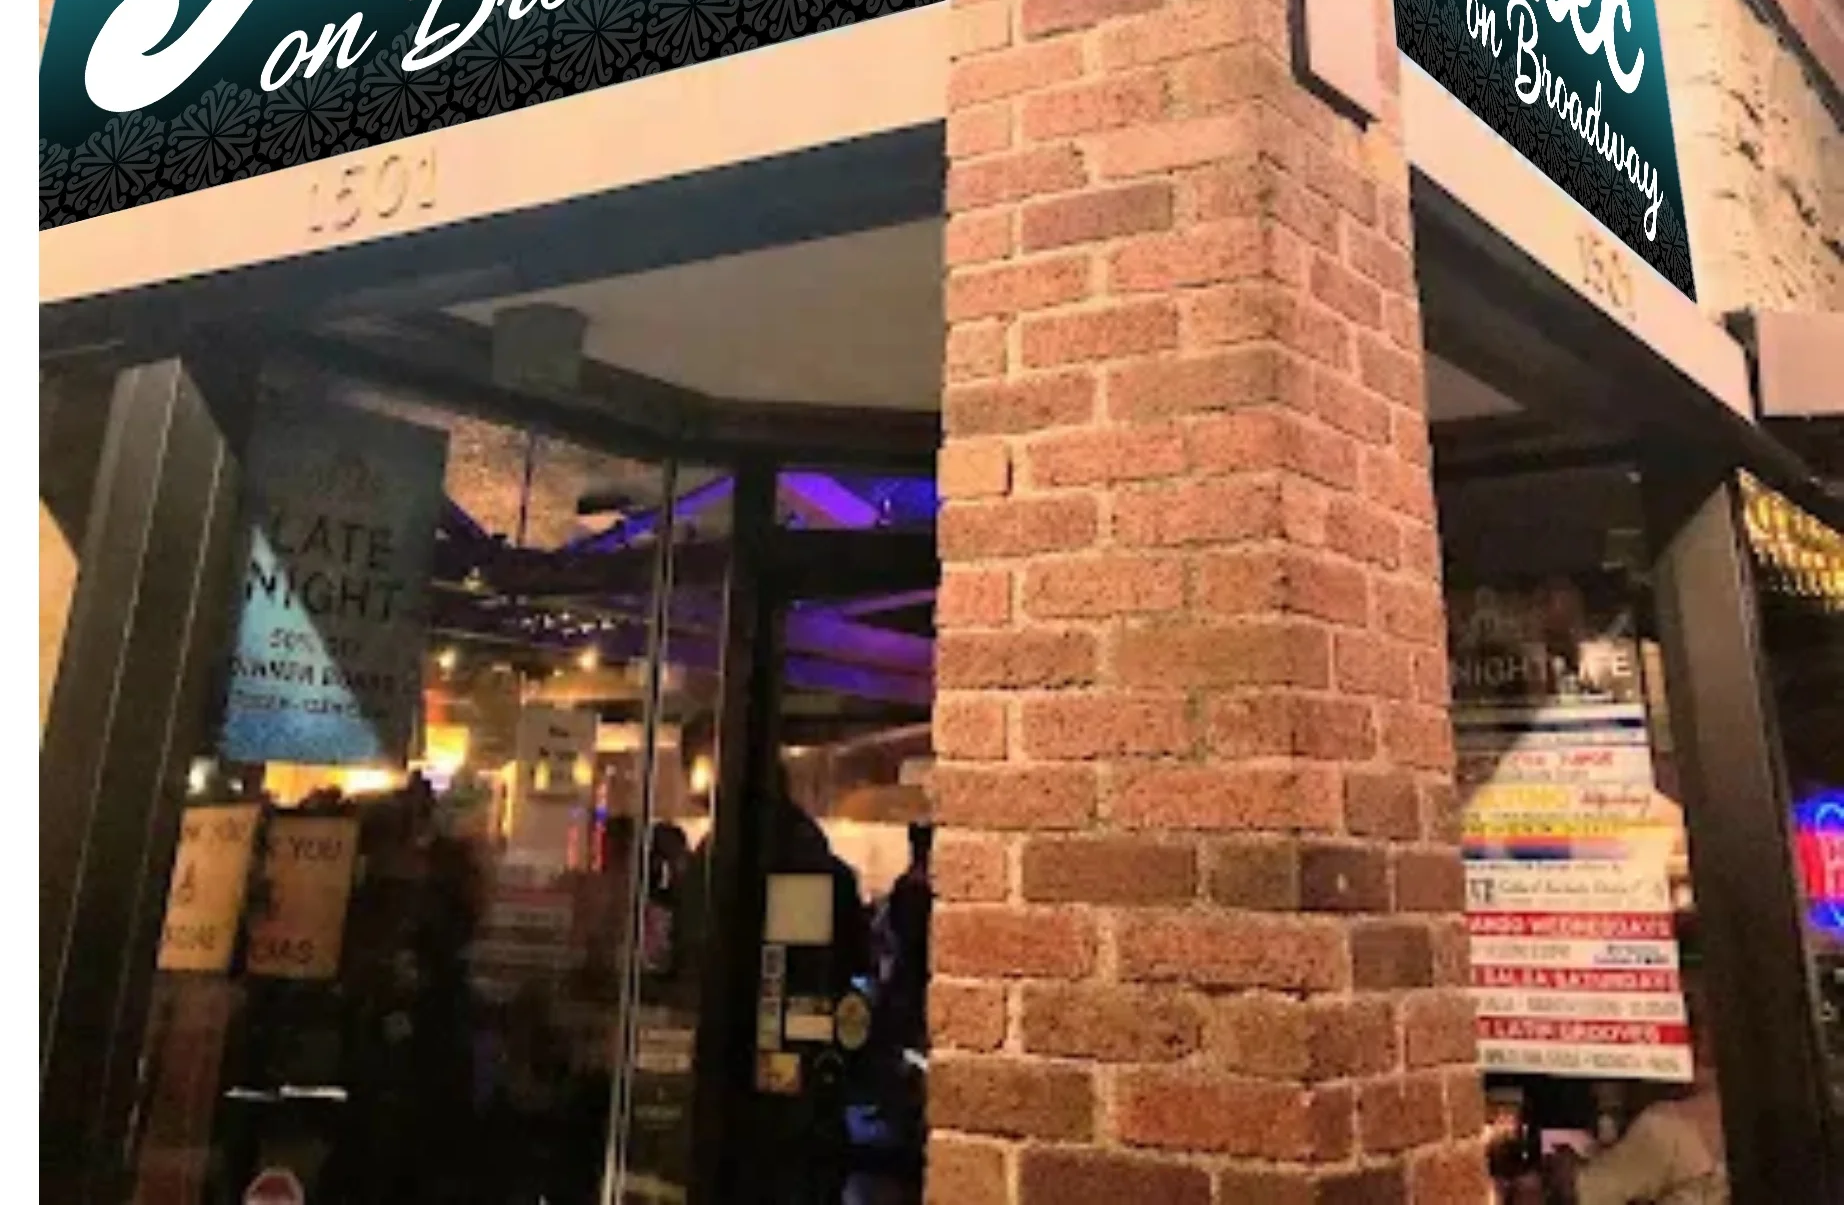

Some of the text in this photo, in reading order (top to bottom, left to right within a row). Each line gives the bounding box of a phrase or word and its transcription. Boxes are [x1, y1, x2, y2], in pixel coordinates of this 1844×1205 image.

[261, 12, 376, 92] on
[308, 147, 437, 232] 1501
[268, 511, 395, 572] LATE
[244, 559, 405, 624] NIGHT
